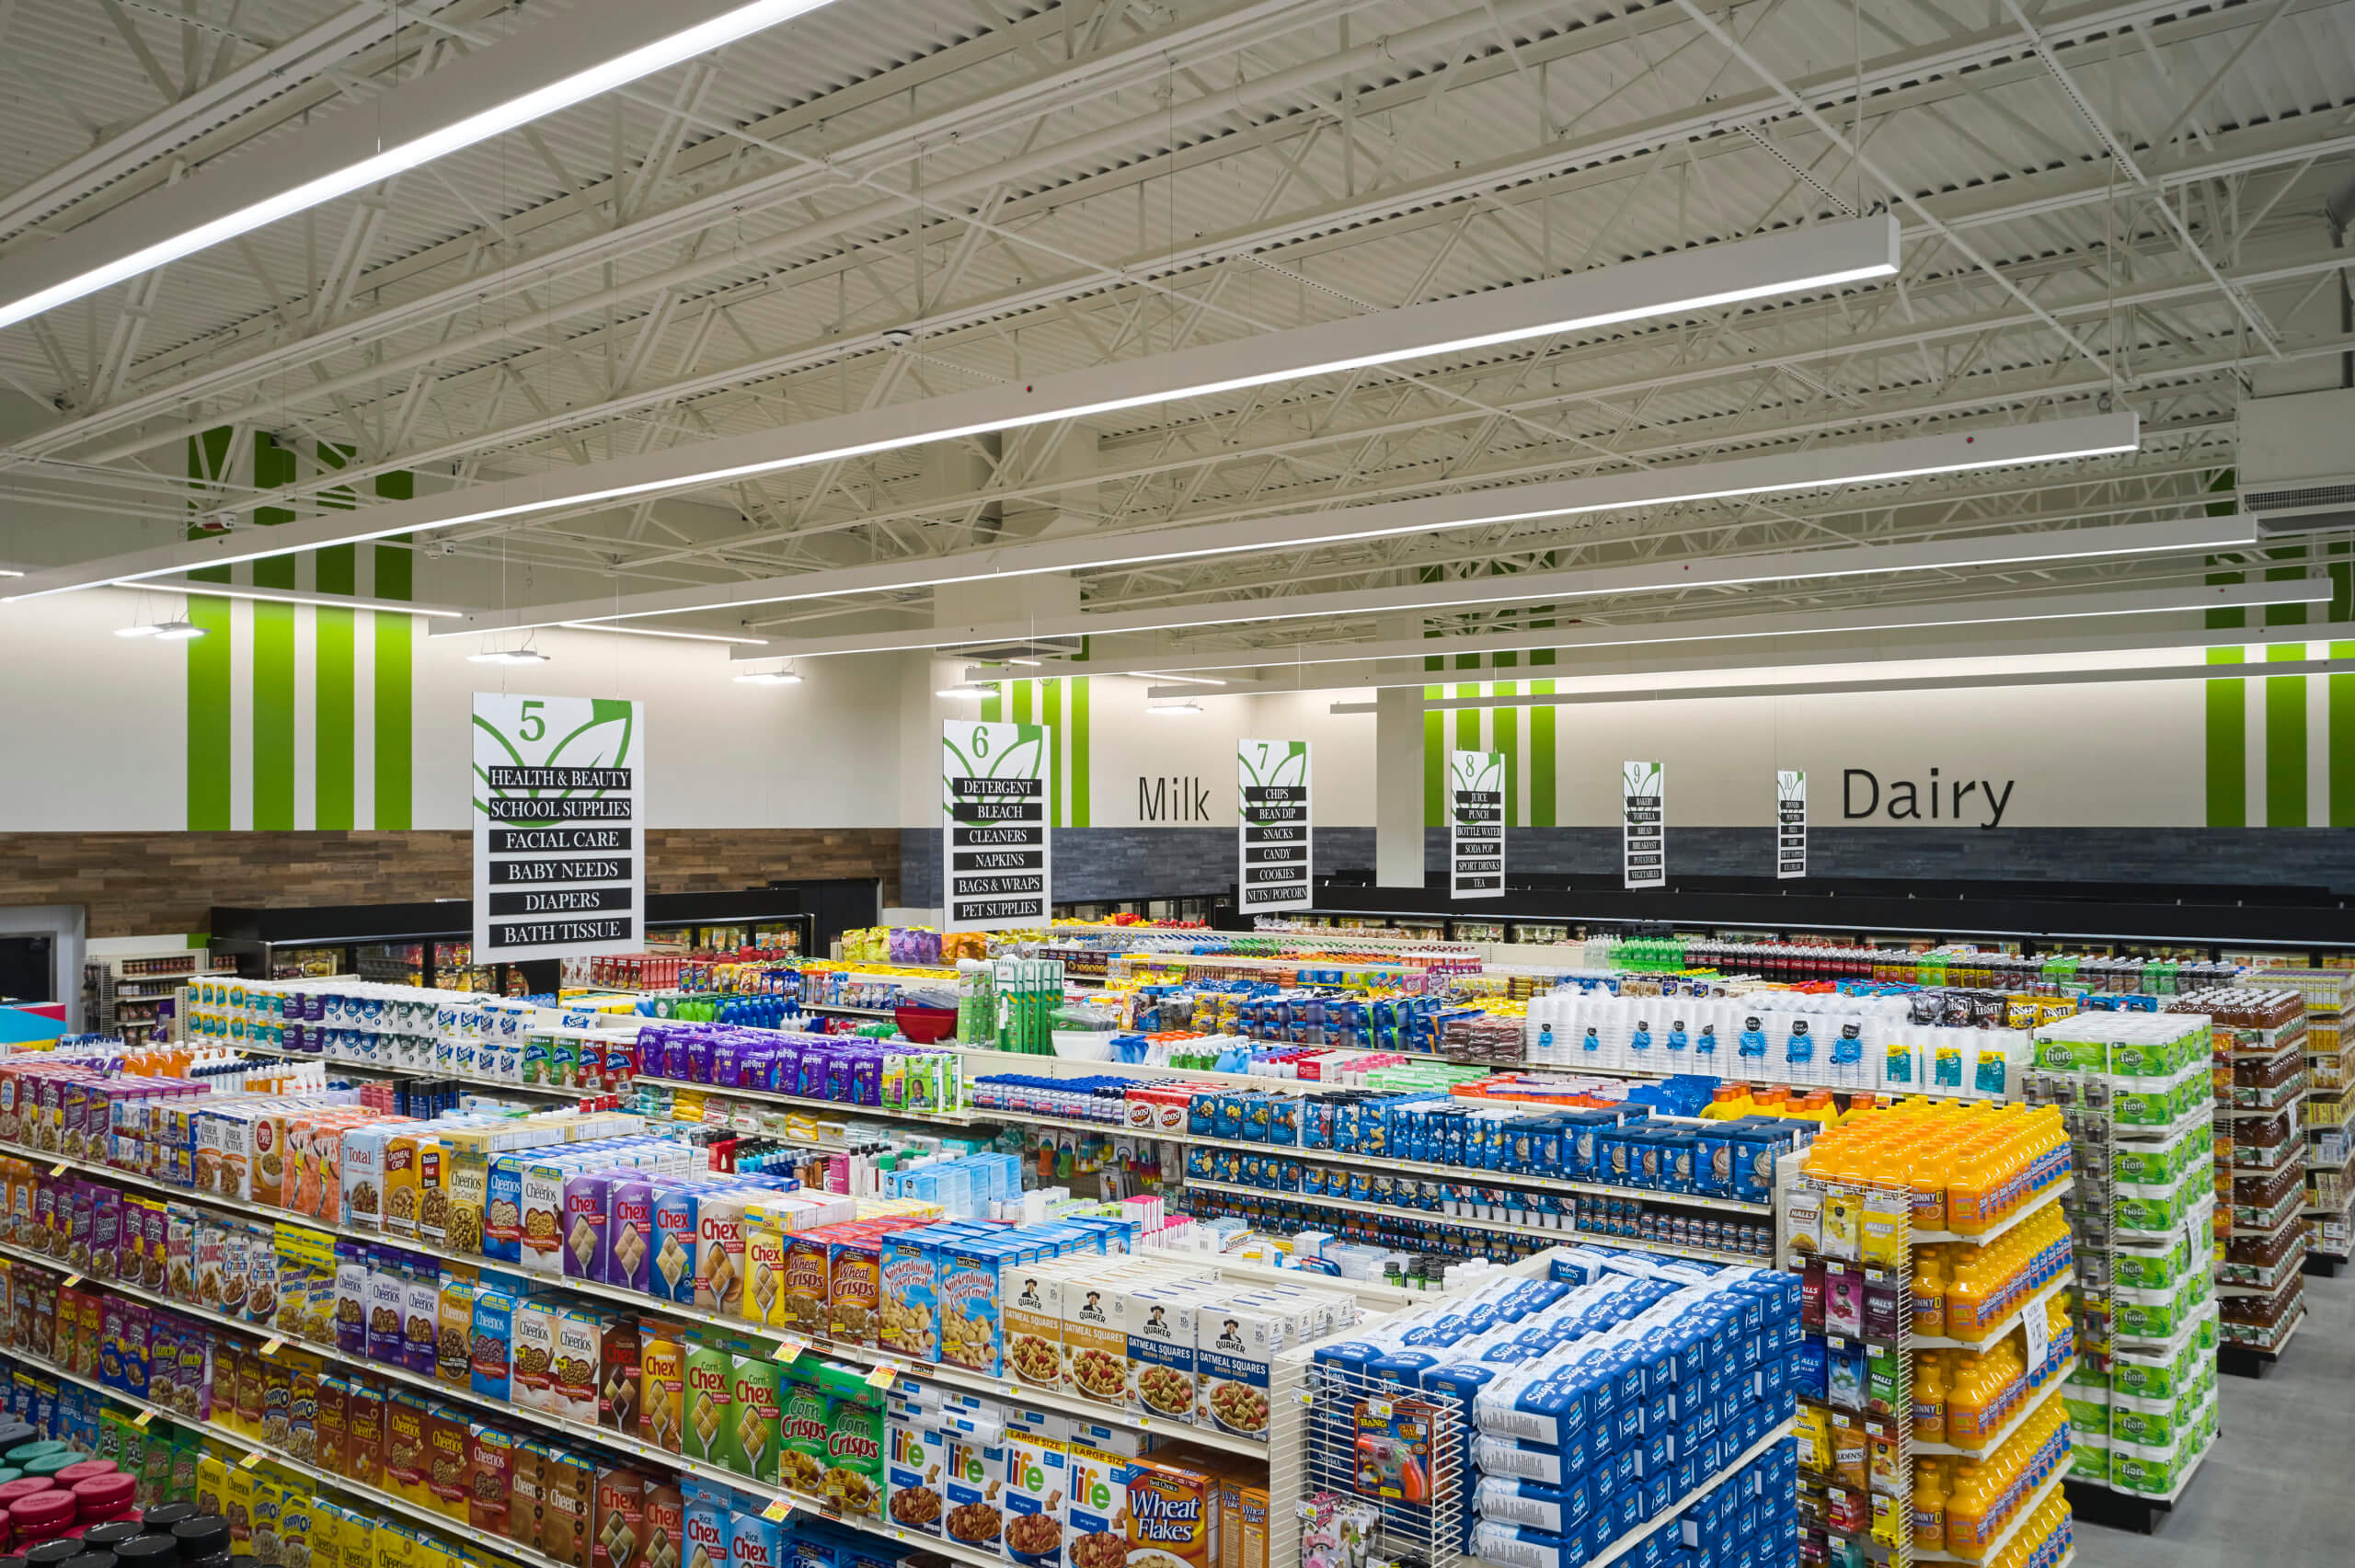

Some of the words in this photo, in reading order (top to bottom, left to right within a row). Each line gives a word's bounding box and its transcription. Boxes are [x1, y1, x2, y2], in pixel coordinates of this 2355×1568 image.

[519, 701, 546, 741] 5
[972, 726, 988, 758] 6
[1258, 744, 1269, 770] 7
[1466, 754, 1474, 777] 8
[491, 769, 554, 786] HEALTH
[557, 772, 567, 785] &
[572, 771, 629, 787] BEAUTY
[1634, 764, 1640, 784] 9
[1785, 773, 1792, 790] 10
[964, 781, 1032, 794] DETERGENT
[1266, 789, 1288, 799] CHIPS
[1139, 777, 1210, 821] Milk
[1471, 793, 1488, 802] JUICE
[1844, 768, 2014, 830] Dairy
[491, 801, 559, 818] SCHOOL
[563, 802, 630, 818] SUPPLIES
[978, 806, 1023, 818] BLEACH
[1259, 809, 1281, 819] BEAN
[1283, 808, 1295, 818] DIP
[1469, 810, 1488, 819] PUNCH
[506, 832, 569, 849] FACIAL
[573, 831, 619, 847] CARE
[970, 830, 1027, 842] CLEANERS
[1263, 830, 1293, 839] SNACKS
[1457, 827, 1481, 836] BOTTLE
[1482, 827, 1500, 836] WATER
[1264, 849, 1291, 859] CANDY
[1465, 845, 1481, 853] SODA
[1482, 844, 1493, 853] POP
[976, 854, 1024, 867] NAPKINS
[1458, 862, 1477, 871] SPORT
[1478, 861, 1499, 869] DRINKS
[509, 864, 558, 880] BABY
[561, 862, 618, 877] NEEDS
[1259, 868, 1294, 880] COOKIES
[959, 879, 988, 892] BAGS
[991, 879, 998, 891] &
[1002, 877, 1040, 890] WRAPS
[1473, 878, 1485, 887] TEA
[526, 892, 600, 910] DIAPERS
[1246, 890, 1268, 901] NUTS
[1273, 887, 1306, 899] POPCORN
[962, 904, 984, 917] PET
[986, 901, 1037, 916] SUPPLIES
[505, 925, 554, 943] BATH
[559, 921, 620, 939] TISSUE
[2045, 1045, 2073, 1063] fiora
[1131, 1108, 1149, 1117] BOOST
[1161, 1111, 1180, 1123] BOOST
[201, 1123, 217, 1135] FIBER
[200, 1133, 220, 1147] ACTIVE
[348, 1148, 371, 1165] Total
[452, 1171, 481, 1189] Cheerios
[491, 1174, 520, 1193] Cheerios
[526, 1182, 556, 1202] Cheerios
[569, 1196, 597, 1213] Chex
[617, 1202, 648, 1220] Chex
[657, 1209, 689, 1229] Chex
[1789, 1209, 1818, 1219] HALLS
[702, 1218, 739, 1241] Chex
[1866, 1222, 1892, 1233] HALLS
[752, 1245, 780, 1262] Chex
[790, 1256, 819, 1273] Wheat
[839, 1263, 869, 1280] Wheat
[884, 1259, 934, 1280] Snickerdoodle
[281, 1269, 307, 1282] Cinnamon
[308, 1278, 335, 1290] Cinnamon
[786, 1273, 824, 1288] Crisps
[945, 1272, 994, 1292] Snickerdoodle
[339, 1276, 362, 1293] Cheerios
[833, 1280, 875, 1297] Crisps
[409, 1295, 434, 1312] Cheerios
[1018, 1298, 1041, 1310] QUAKER
[1869, 1297, 1892, 1308] HALLS
[442, 1304, 469, 1322] Cheerios
[477, 1311, 504, 1331] Cheerios
[1005, 1310, 1028, 1324] OATMEAL
[1031, 1316, 1059, 1330] SQUARES
[1079, 1310, 1106, 1324] QUAKER
[2124, 1310, 2147, 1324] fiora
[520, 1322, 548, 1341] Cheerios
[1064, 1322, 1092, 1337] OATMEAL
[1094, 1330, 1124, 1343] SQUARES
[1143, 1325, 1171, 1339] QUAKER
[560, 1332, 592, 1351] Cheerios
[1129, 1338, 1157, 1352] OATMEAL
[1159, 1346, 1190, 1359] SQUARES
[1216, 1340, 1246, 1354] QUAKER
[605, 1345, 635, 1363] Chex
[646, 1356, 675, 1376] Chex
[701, 1362, 718, 1372] Corn
[1200, 1354, 1230, 1367] OATMEAL
[1232, 1361, 1266, 1375] SQUARES
[690, 1368, 726, 1390] Chex
[749, 1375, 765, 1385] Corn
[1871, 1373, 1892, 1385] HALLS
[736, 1379, 775, 1403] Chex
[1526, 1382, 1557, 1404] Sugar
[790, 1398, 820, 1420] Corn
[1598, 1395, 1612, 1410] Sugar
[782, 1416, 827, 1441] Crisps
[838, 1414, 870, 1436] Corn
[1360, 1418, 1388, 1427] BANG
[829, 1434, 879, 1459] Crisps
[891, 1427, 925, 1467] life
[1012, 1430, 1040, 1444] LARGE
[1041, 1438, 1061, 1449] SIZE
[474, 1446, 505, 1468] Cheerios
[948, 1442, 984, 1483] life
[1074, 1447, 1105, 1460] LARGE
[1108, 1456, 1126, 1466] SIZE
[1007, 1448, 1044, 1492] life
[1071, 1464, 1110, 1509] life
[1161, 1482, 1178, 1493] Choice
[1130, 1490, 1199, 1518] Wheat
[1243, 1505, 1266, 1516] Wheat
[1244, 1515, 1263, 1524] Flakes
[745, 1531, 758, 1542] Rice
[1137, 1518, 1192, 1540] Flakes
[733, 1536, 767, 1562] Chex
